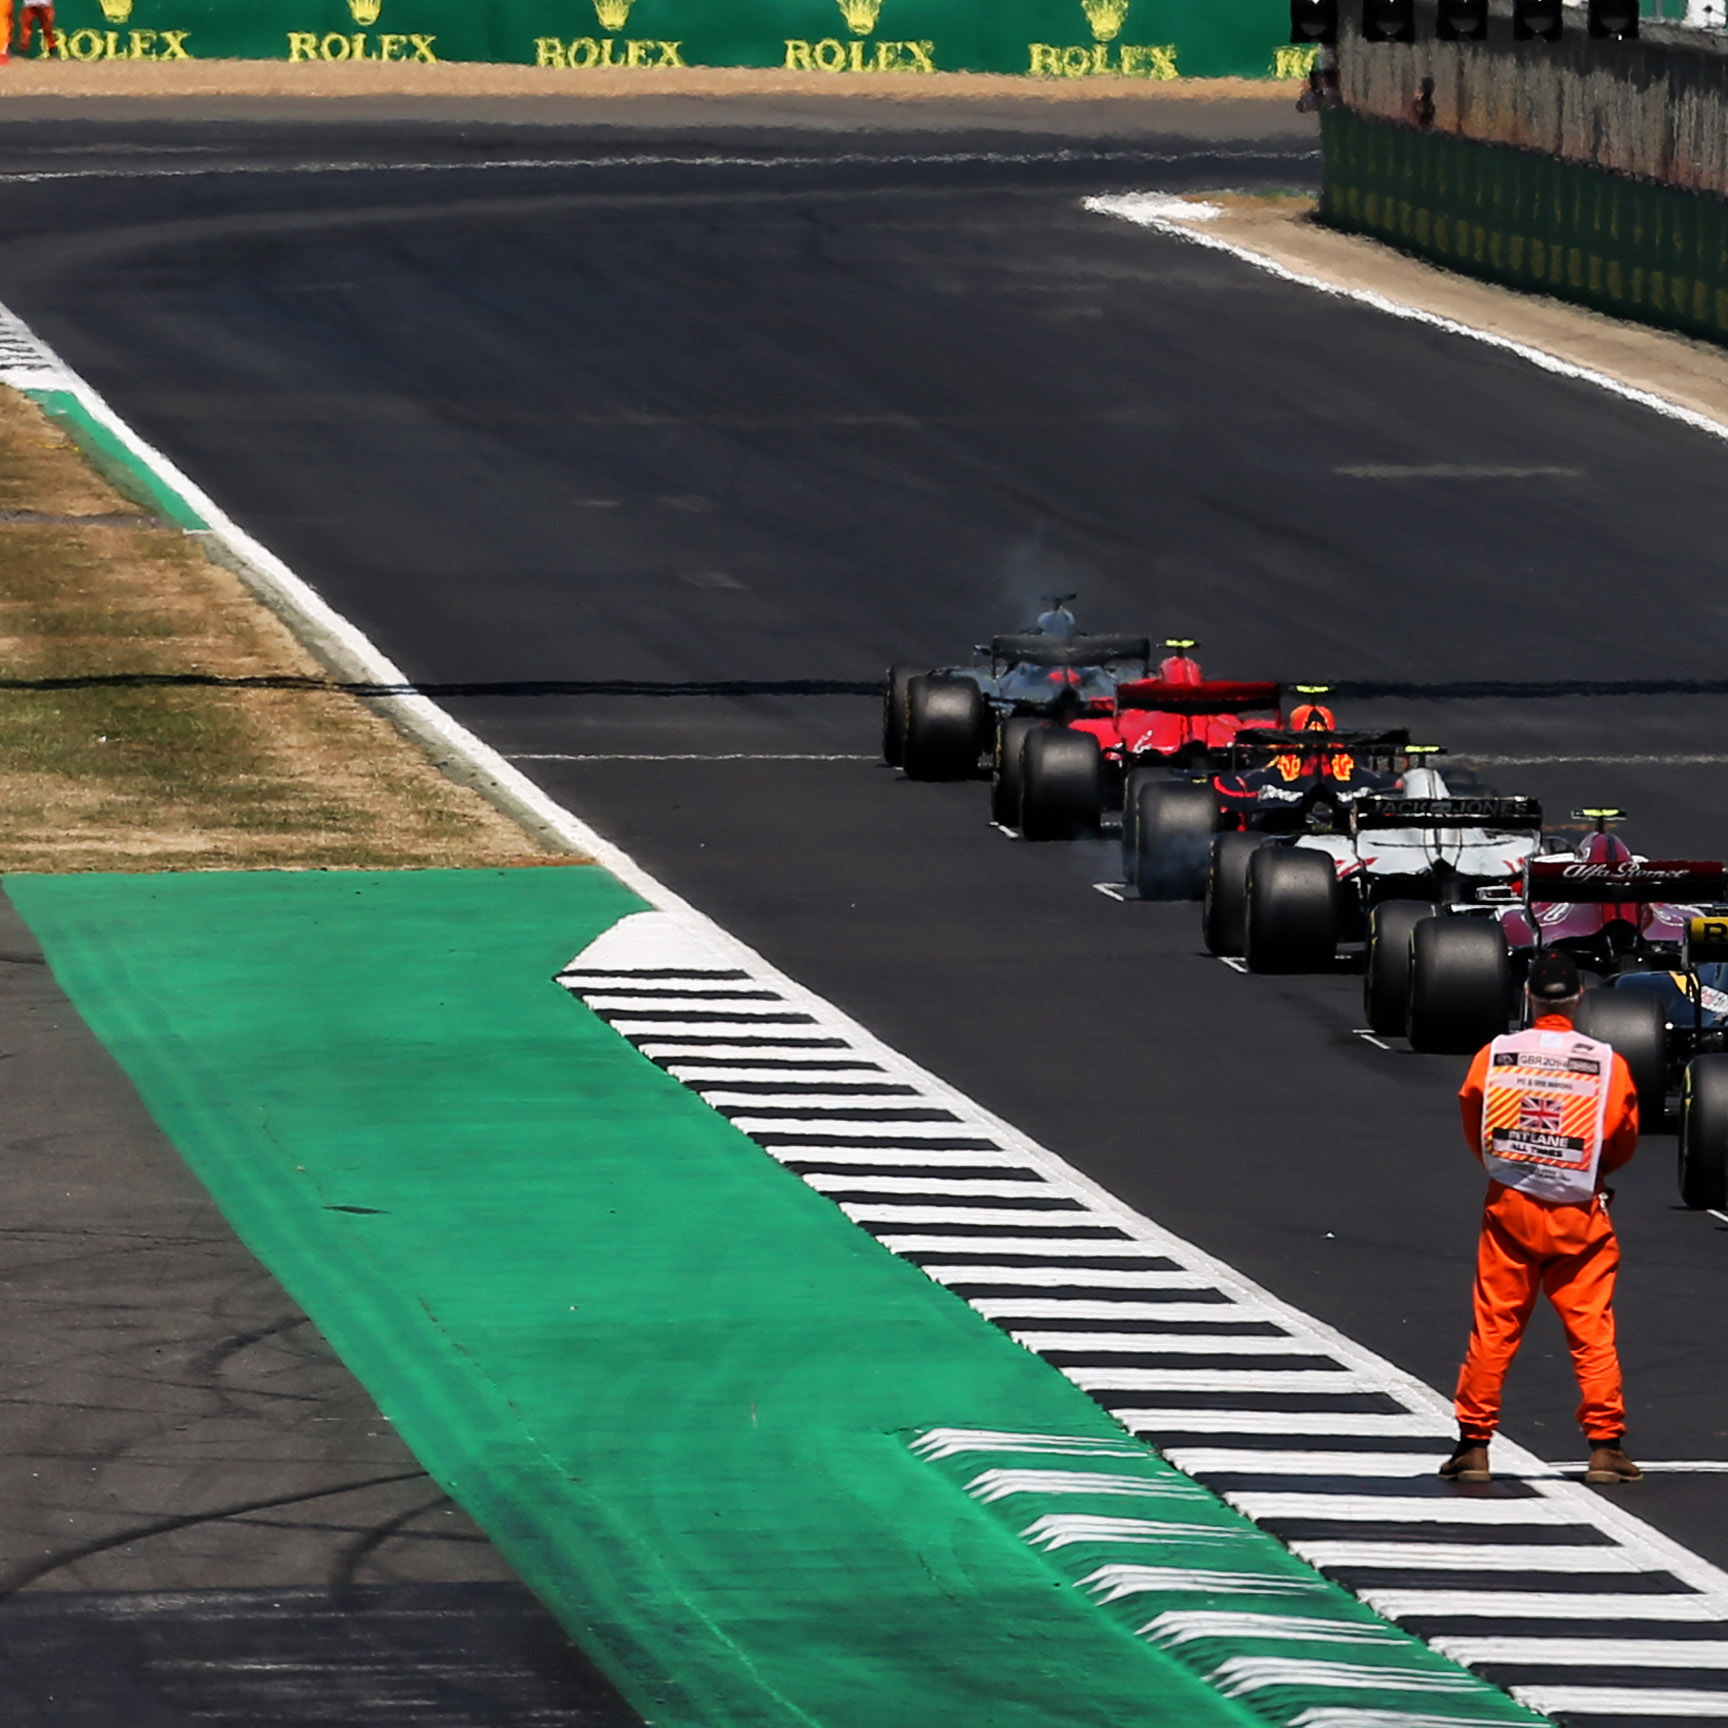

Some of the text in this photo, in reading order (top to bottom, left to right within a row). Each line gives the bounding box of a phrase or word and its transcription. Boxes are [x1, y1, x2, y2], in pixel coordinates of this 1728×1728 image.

[37, 28, 192, 62] ROLEX
[287, 32, 439, 63] ROLEX
[534, 36, 685, 69] ROLEX
[784, 38, 935, 73] ROLEX
[1028, 42, 1179, 80] ROLEX
[1563, 863, 1613, 881] Alfa
[1530, 1132, 1569, 1148] LANE
